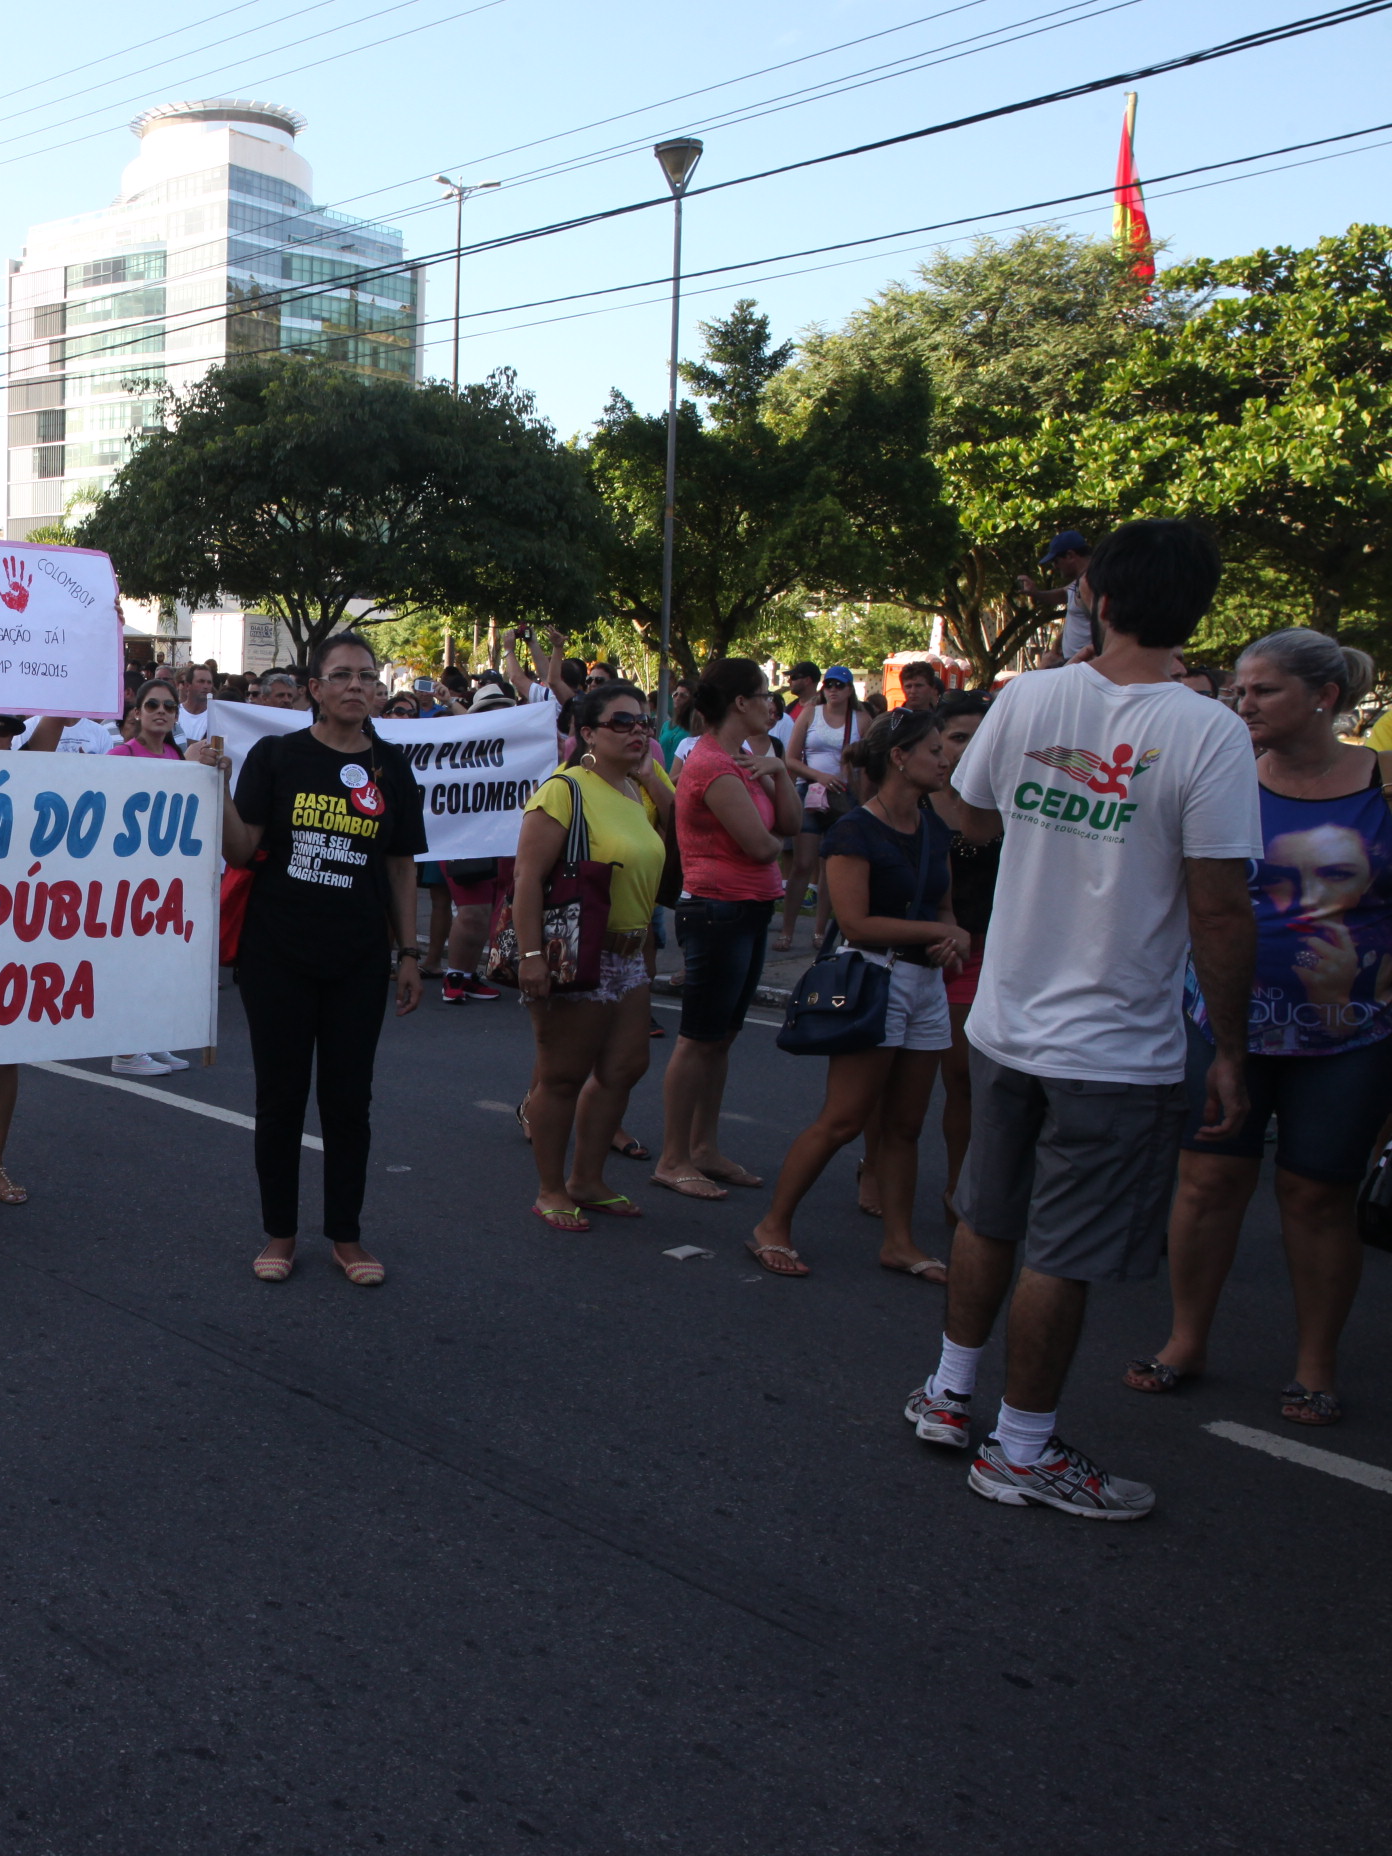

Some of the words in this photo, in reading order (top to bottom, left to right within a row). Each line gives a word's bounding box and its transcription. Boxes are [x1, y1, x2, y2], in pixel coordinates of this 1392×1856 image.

[37, 558, 96, 609] COLOMBO!
[44, 627, 66, 645] JÁ!
[18, 660, 68, 678] 198/2015
[435, 738, 505, 770] PLANO
[293, 792, 348, 815] BASTA
[1014, 781, 1138, 832] CEDUF
[29, 790, 107, 859] DO
[112, 790, 204, 858] SUL
[291, 808, 380, 839] COLOMBO!
[1040, 821, 1050, 830] DE
[291, 830, 327, 846] HONRE
[328, 835, 352, 851] SEU
[290, 853, 311, 868] COM
[313, 858, 322, 871] O
[292, 841, 368, 866] COMPROMISSO
[287, 864, 354, 889] MAGISTÉRIO!
